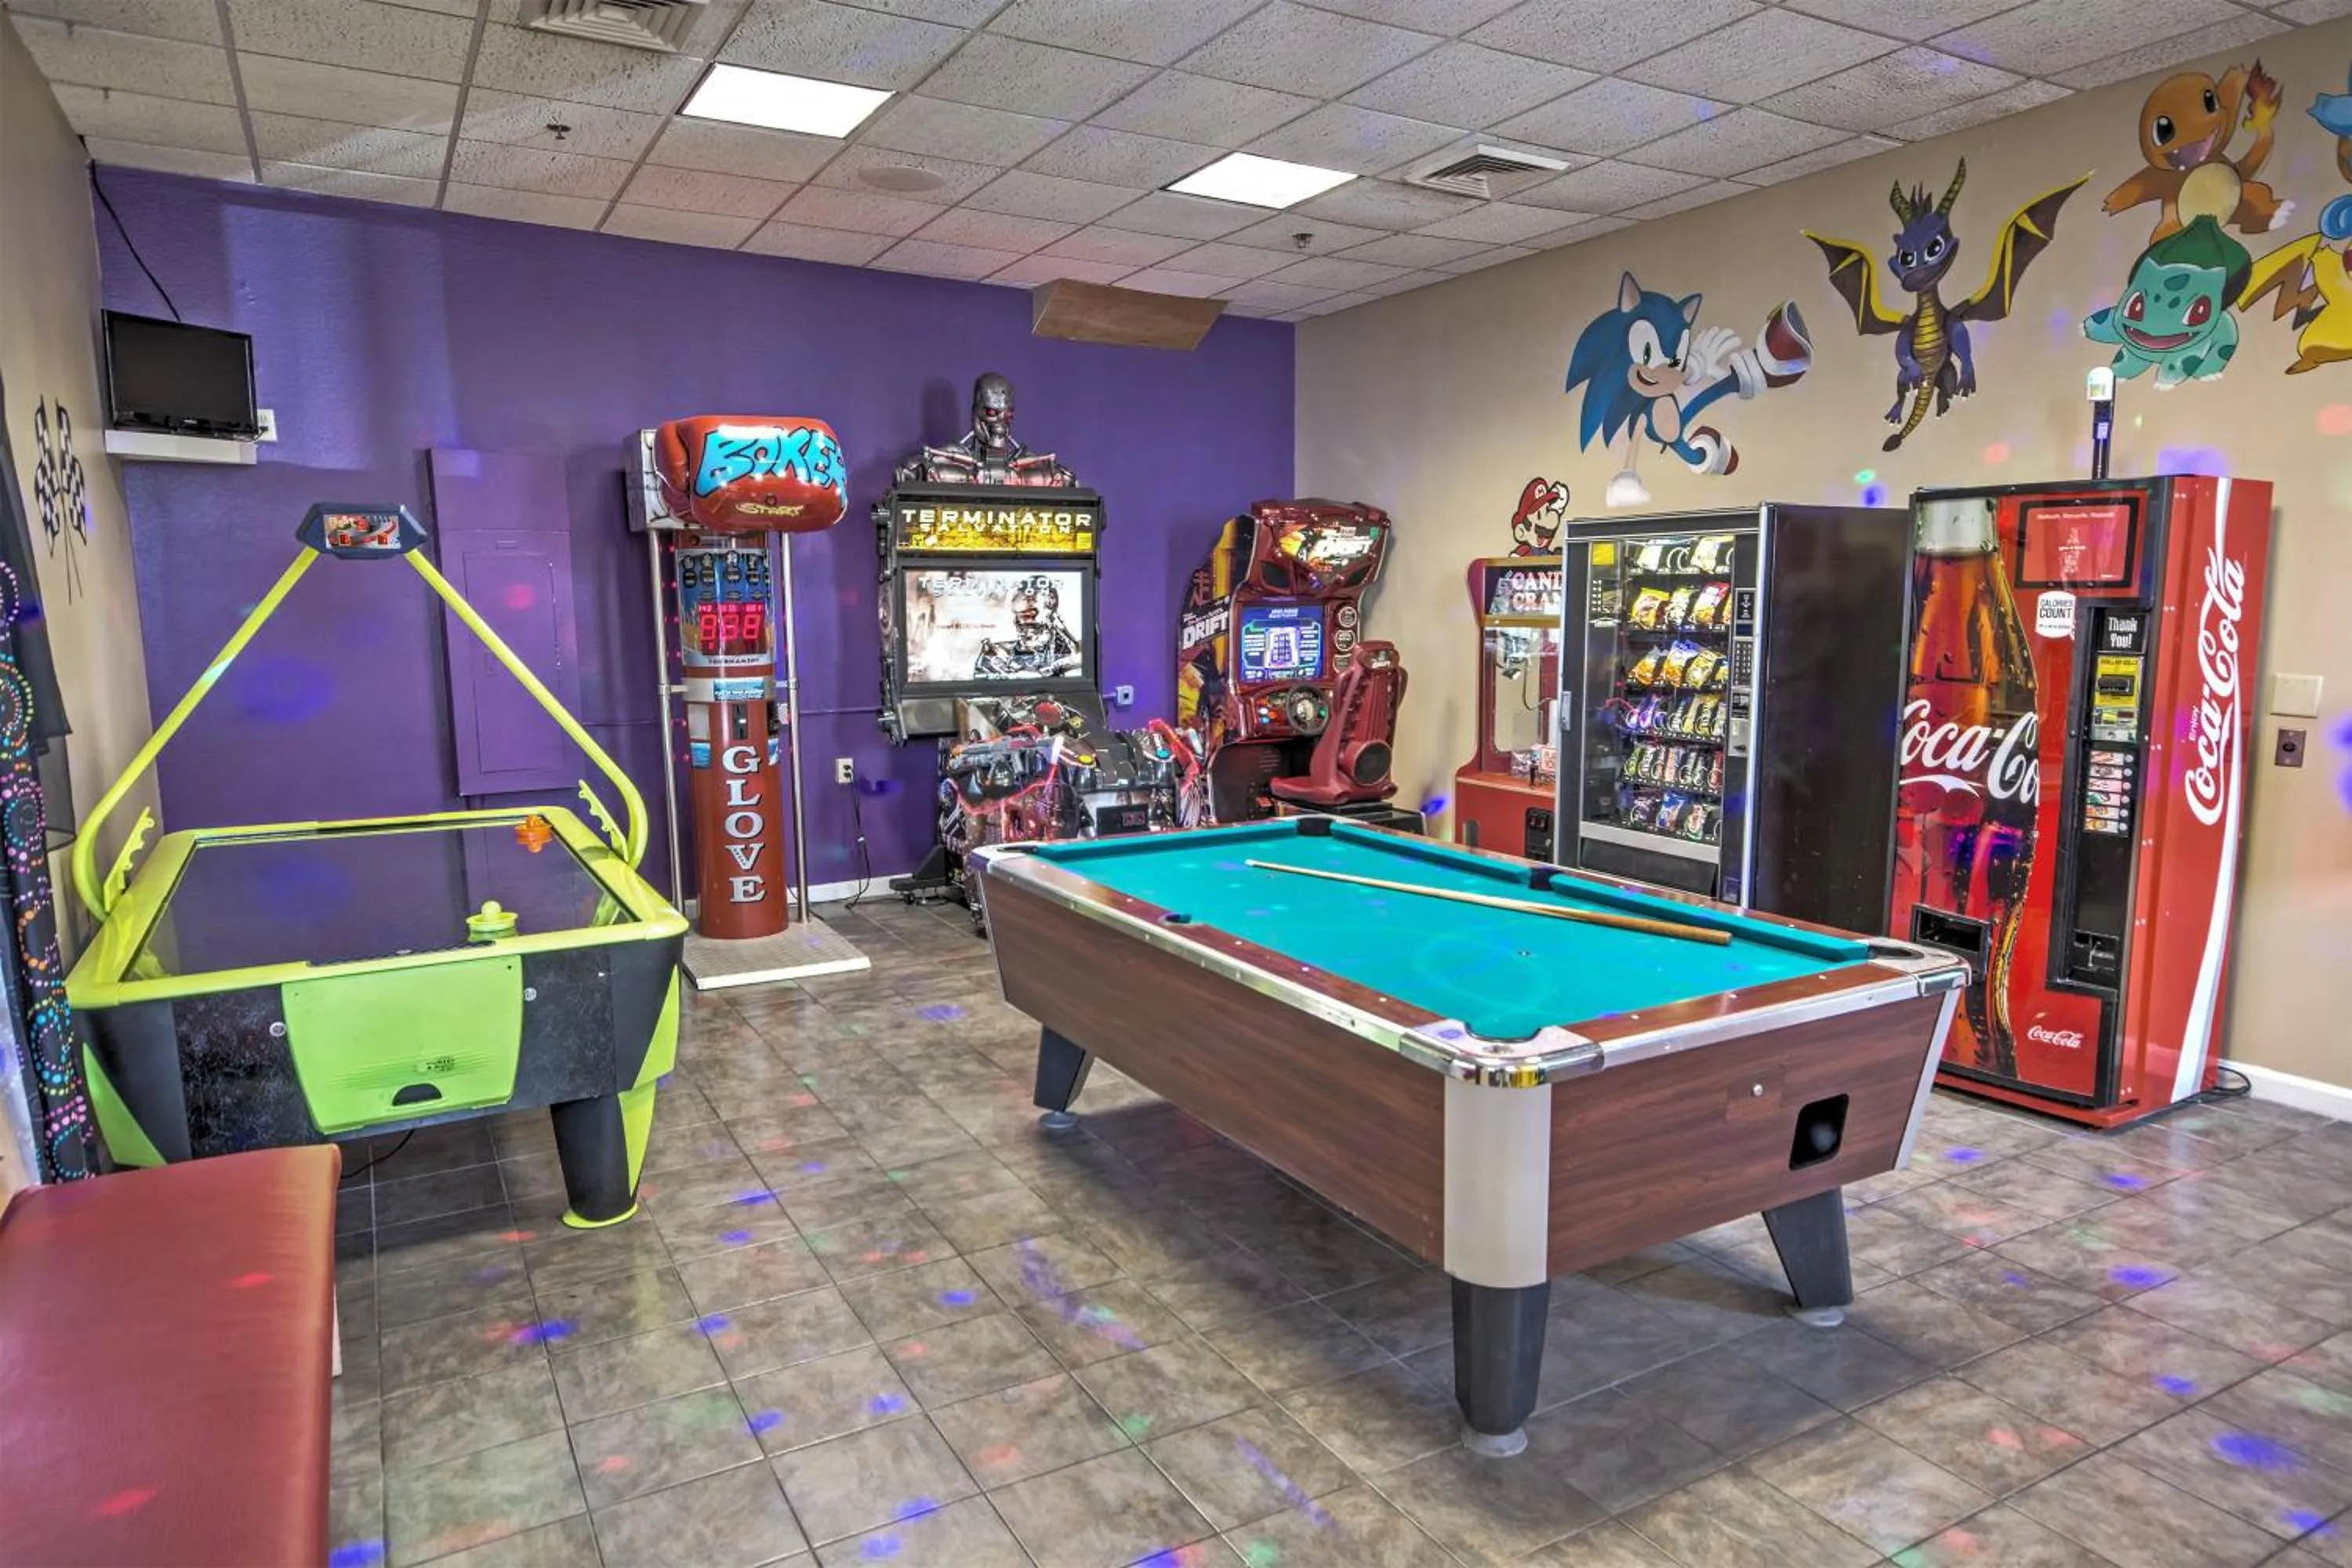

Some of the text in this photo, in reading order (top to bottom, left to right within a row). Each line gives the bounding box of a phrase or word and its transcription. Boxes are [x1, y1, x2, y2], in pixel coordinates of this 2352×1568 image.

[902, 510, 1092, 526] TERMINATOR
[919, 524, 1071, 534] SALVATION
[1512, 571, 1563, 590] CAND
[2039, 608, 2073, 619] COUNT
[1181, 611, 1229, 650] DRIFT
[2108, 617, 2137, 632] Thank
[2111, 633, 2132, 648] You!
[2185, 546, 2245, 826] Coca-Cola
[722, 746, 765, 902] GLOVE
[2027, 1025, 2084, 1048] Coca-Cola
